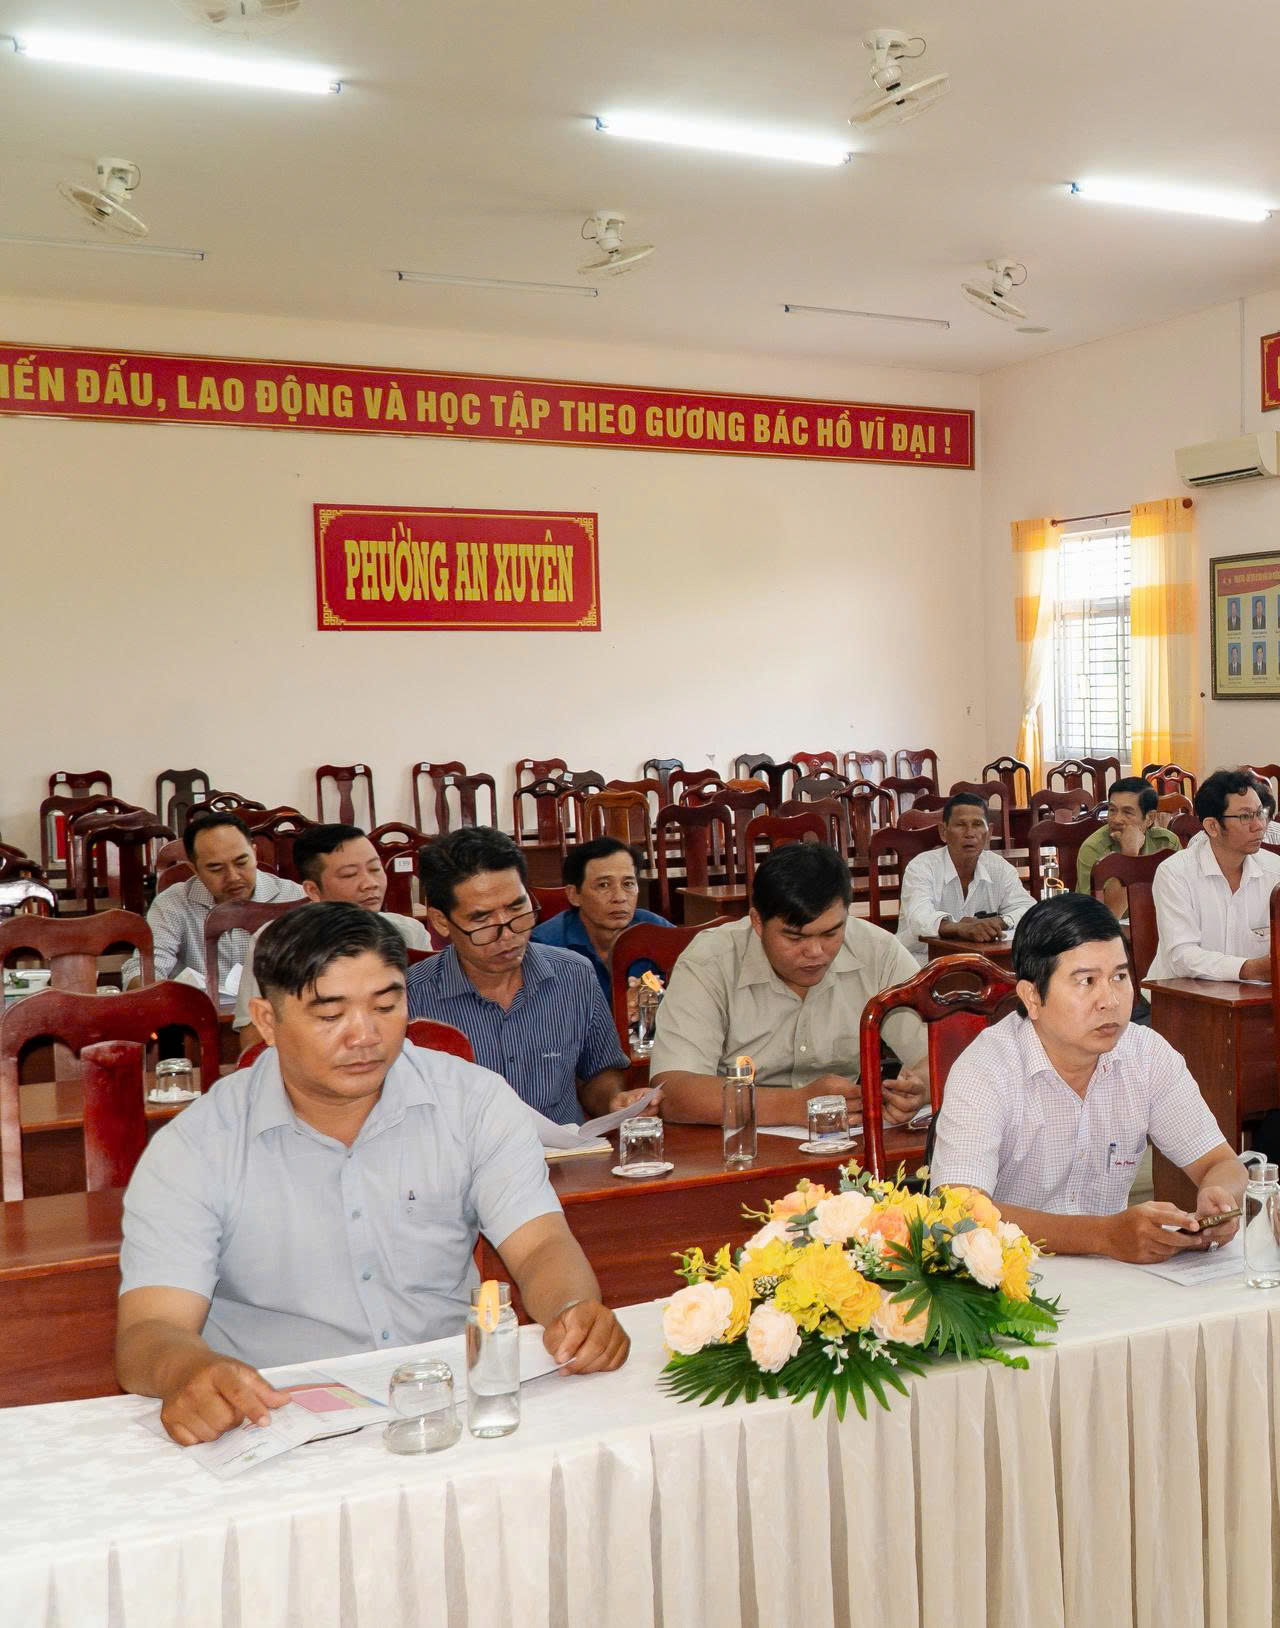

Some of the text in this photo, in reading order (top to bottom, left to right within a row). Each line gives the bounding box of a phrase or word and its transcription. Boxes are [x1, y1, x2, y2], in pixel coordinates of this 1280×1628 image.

[76, 357, 166, 412] ĐẤU,
[177, 375, 245, 412] LAO
[254, 374, 353, 422] ĐỘNG
[363, 381, 407, 421] VÀ
[416, 390, 481, 431] HỌC
[489, 390, 550, 435] TẬP
[560, 400, 636, 435] THEO
[645, 405, 745, 442] GƯƠNG
[753, 408, 809, 446] BÁC
[817, 409, 852, 449] HỒ
[860, 416, 885, 450] VĨ
[892, 423, 935, 459] ĐẠI
[944, 427, 951, 455] !
[344, 521, 574, 602] PHƯỜNG AN XUYÊN
